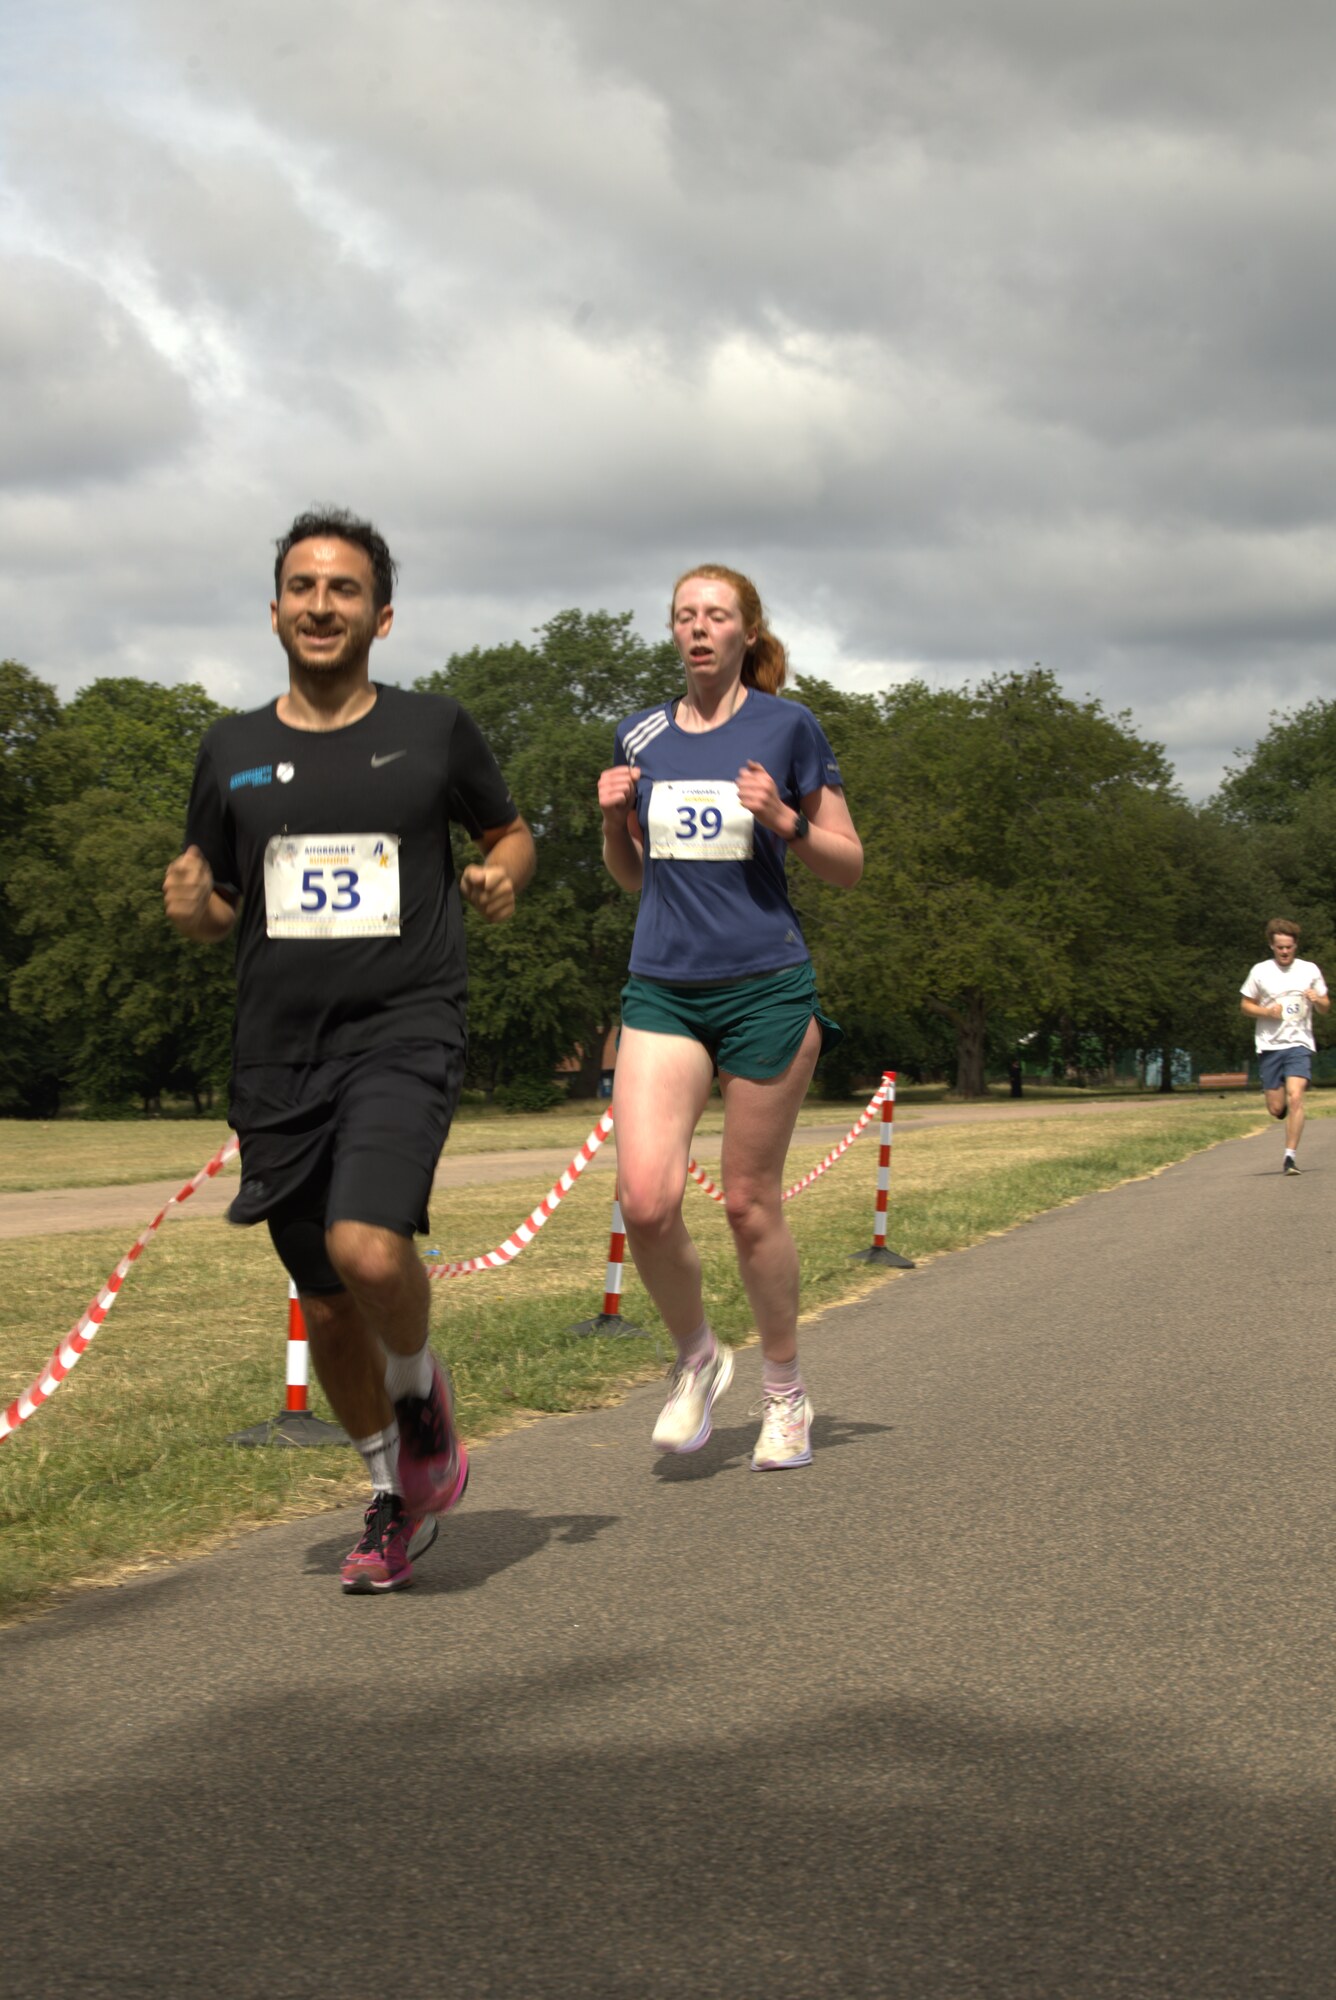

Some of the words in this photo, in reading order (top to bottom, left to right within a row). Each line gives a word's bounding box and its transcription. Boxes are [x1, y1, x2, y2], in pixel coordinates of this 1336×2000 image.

[675, 806, 723, 840] 39
[301, 868, 361, 912] 53
[1286, 1003, 1300, 1015] 63
